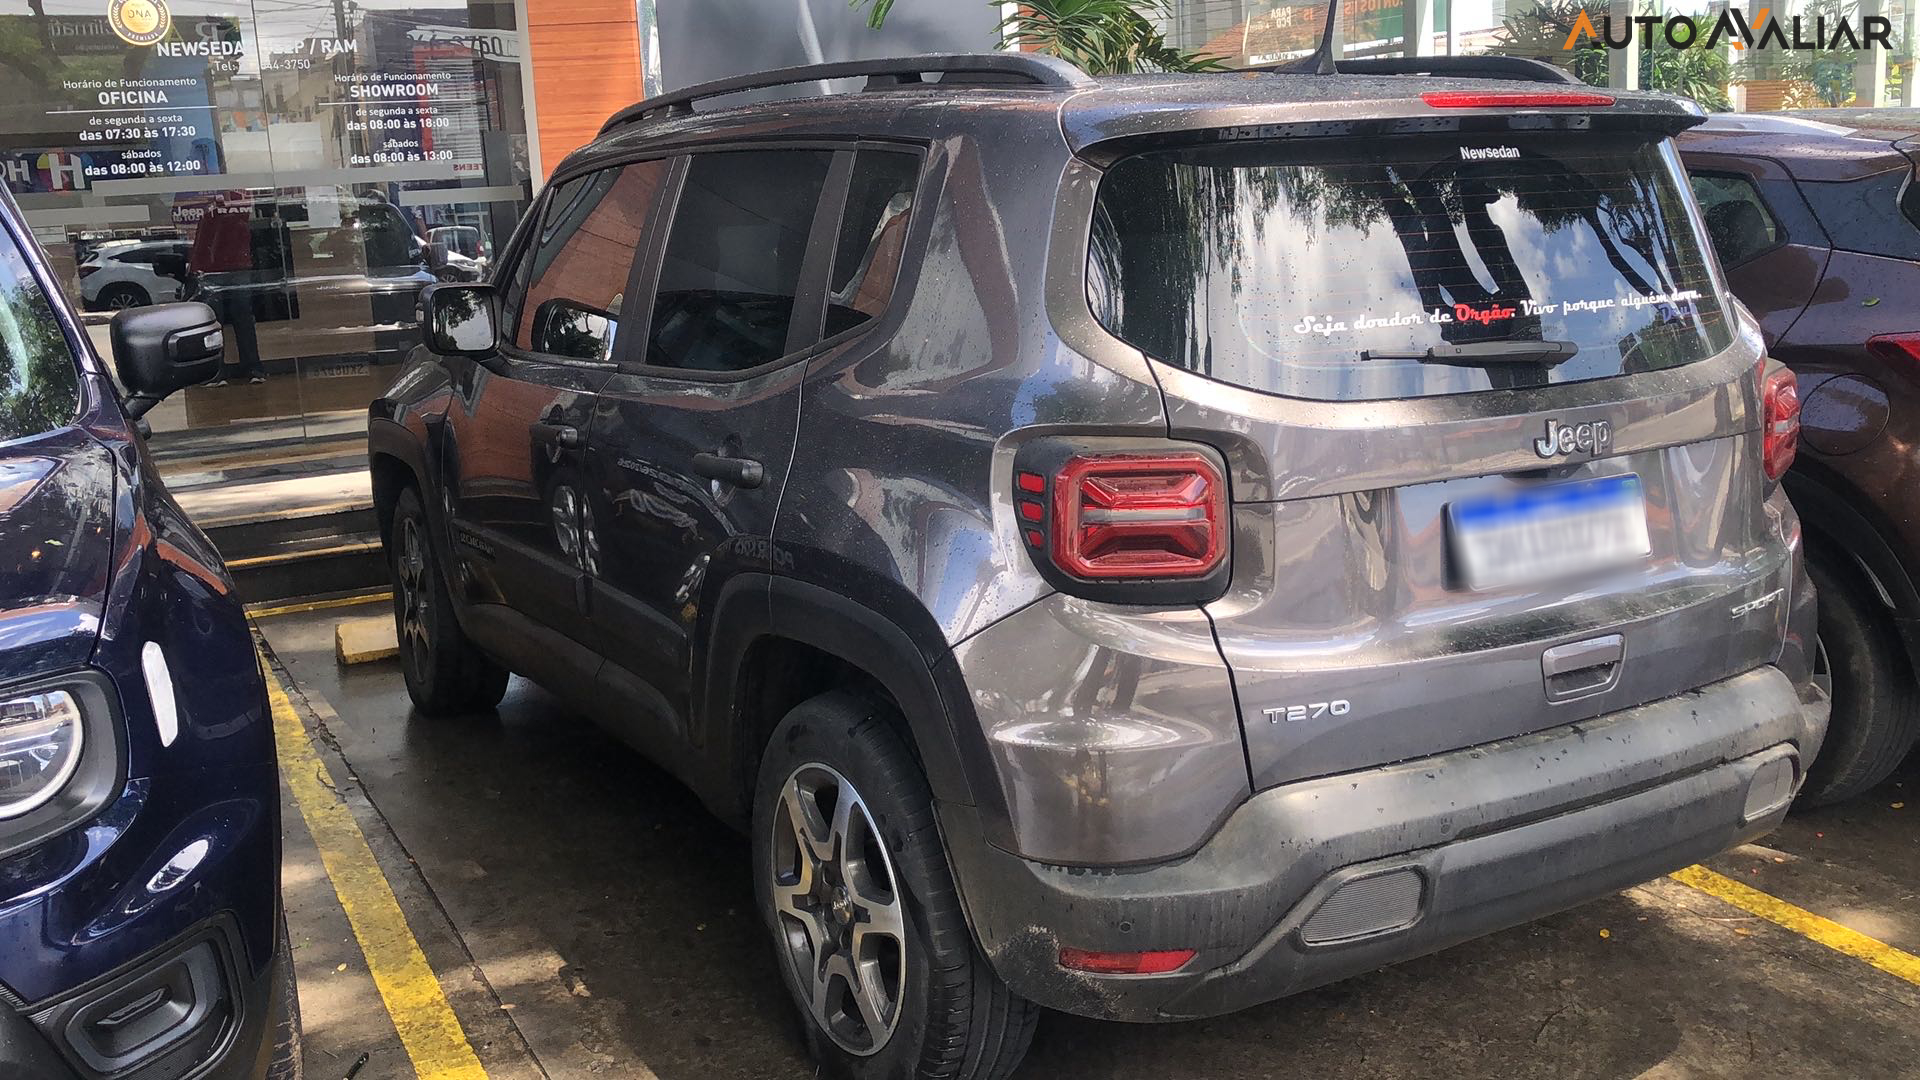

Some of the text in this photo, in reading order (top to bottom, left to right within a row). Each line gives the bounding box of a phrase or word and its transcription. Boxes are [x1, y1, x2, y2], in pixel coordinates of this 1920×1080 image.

[157, 41, 245, 57] NEWSEDA
[321, 38, 358, 53] RAM
[64, 77, 197, 89] Horário de Funcionamento
[334, 72, 451, 82] Horário de Funcionamento
[350, 83, 439, 98] SHOWROOM
[98, 91, 168, 105] OFICINA
[355, 107, 367, 116] de
[369, 107, 406, 117] segunda
[415, 106, 438, 115] sexta
[89, 116, 102, 125] de
[104, 114, 146, 126] segunda
[157, 114, 183, 123] sexta
[346, 118, 449, 131] das 08:00 às 18:00
[79, 126, 196, 141] das 07:30 às 17:30
[382, 138, 419, 148] sábados
[121, 149, 162, 160] sábados
[350, 150, 453, 164] das 08:00 às 13:00
[1460, 145, 1520, 160] Newsedan
[85, 160, 200, 176] das 08:00 às 12:00
[173, 206, 252, 217] Jeep RAM
[1294, 315, 1348, 336] Seja
[1353, 312, 1424, 330] doador
[1430, 308, 1453, 323] de
[1520, 299, 1558, 316] Vivo
[1564, 299, 1615, 315] porque
[1621, 291, 1667, 311] alguém
[1534, 418, 1612, 459] Jeep
[1732, 588, 1784, 619] SPORT
[1262, 699, 1351, 724] T270
